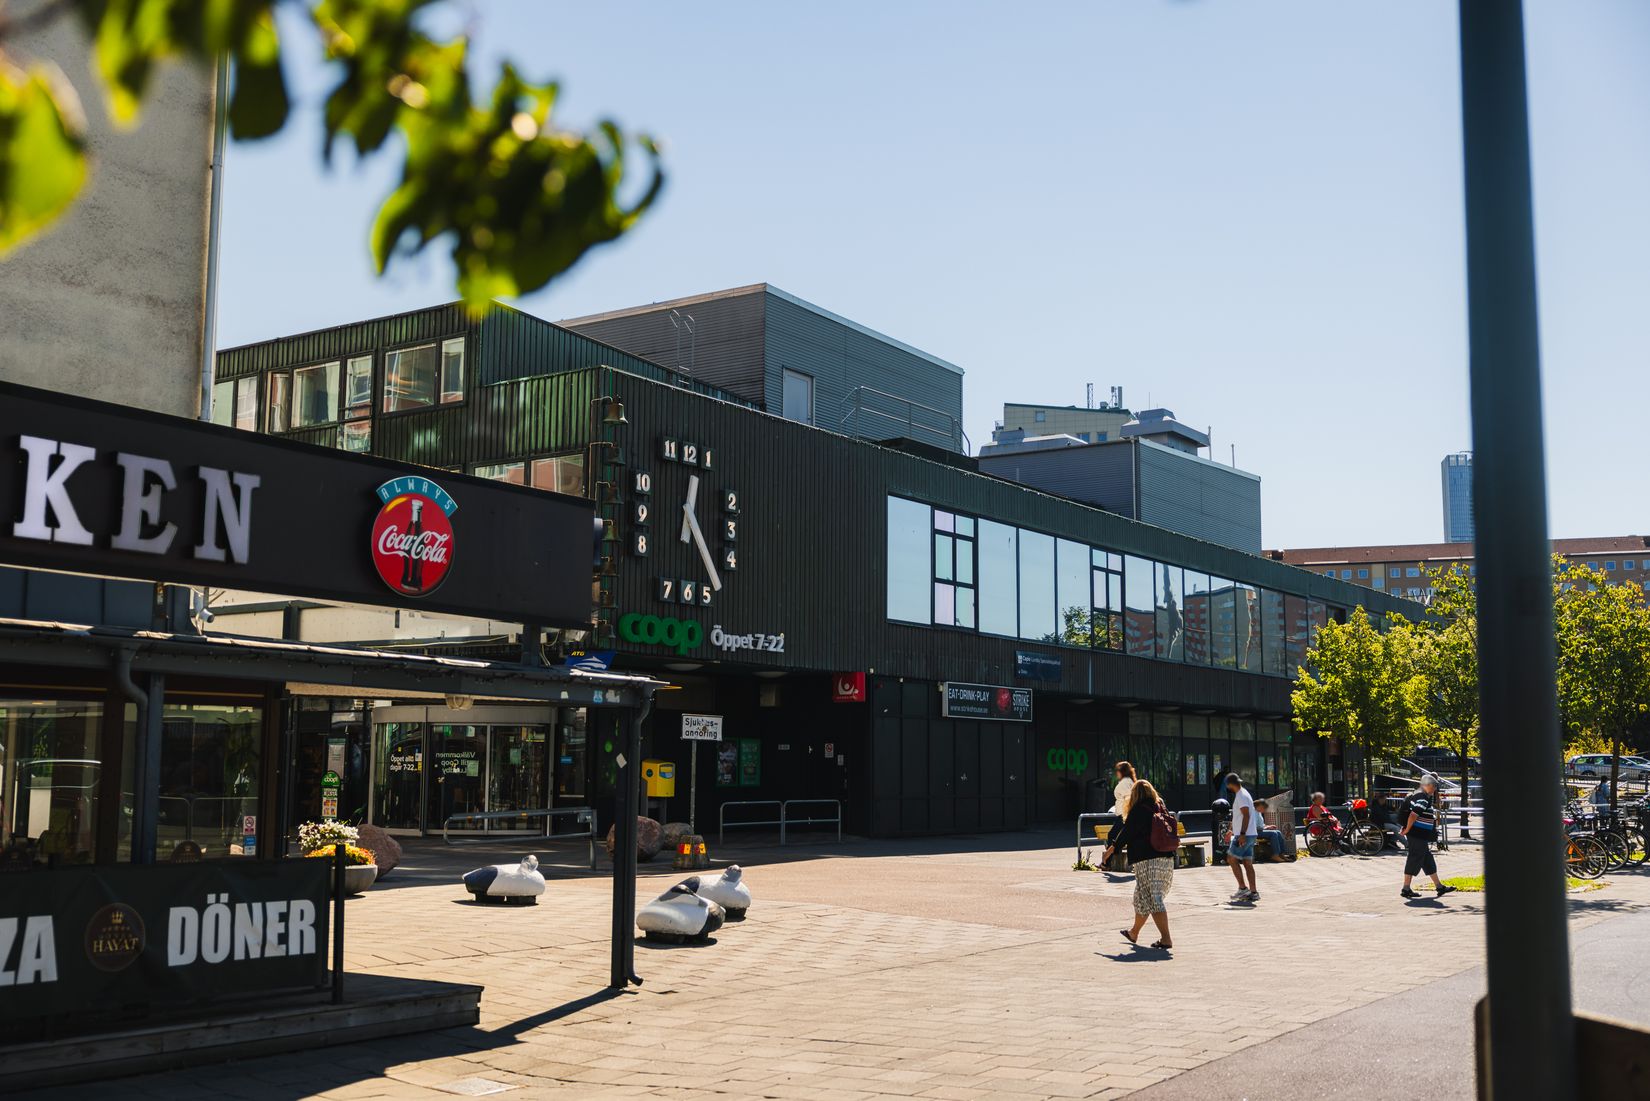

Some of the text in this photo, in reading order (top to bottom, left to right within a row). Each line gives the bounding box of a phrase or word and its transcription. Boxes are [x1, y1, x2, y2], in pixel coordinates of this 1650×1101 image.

[664, 440, 711, 467] 11 12 1
[380, 479, 453, 510] ALWAYS
[636, 473, 650, 492] 10
[13, 434, 262, 564] KEN
[728, 493, 736, 510] 2
[638, 505, 647, 522] 9
[728, 521, 736, 539] 3
[378, 525, 449, 563] Coca-Cola
[638, 536, 647, 553] 8
[727, 551, 736, 568] 4
[663, 581, 711, 604] 7 6 5
[619, 613, 703, 655] coop
[711, 625, 784, 653] Öppet 7-22
[1047, 747, 1089, 776] coop
[168, 893, 316, 967] DÖNER
[93, 937, 139, 953] HAYAT
